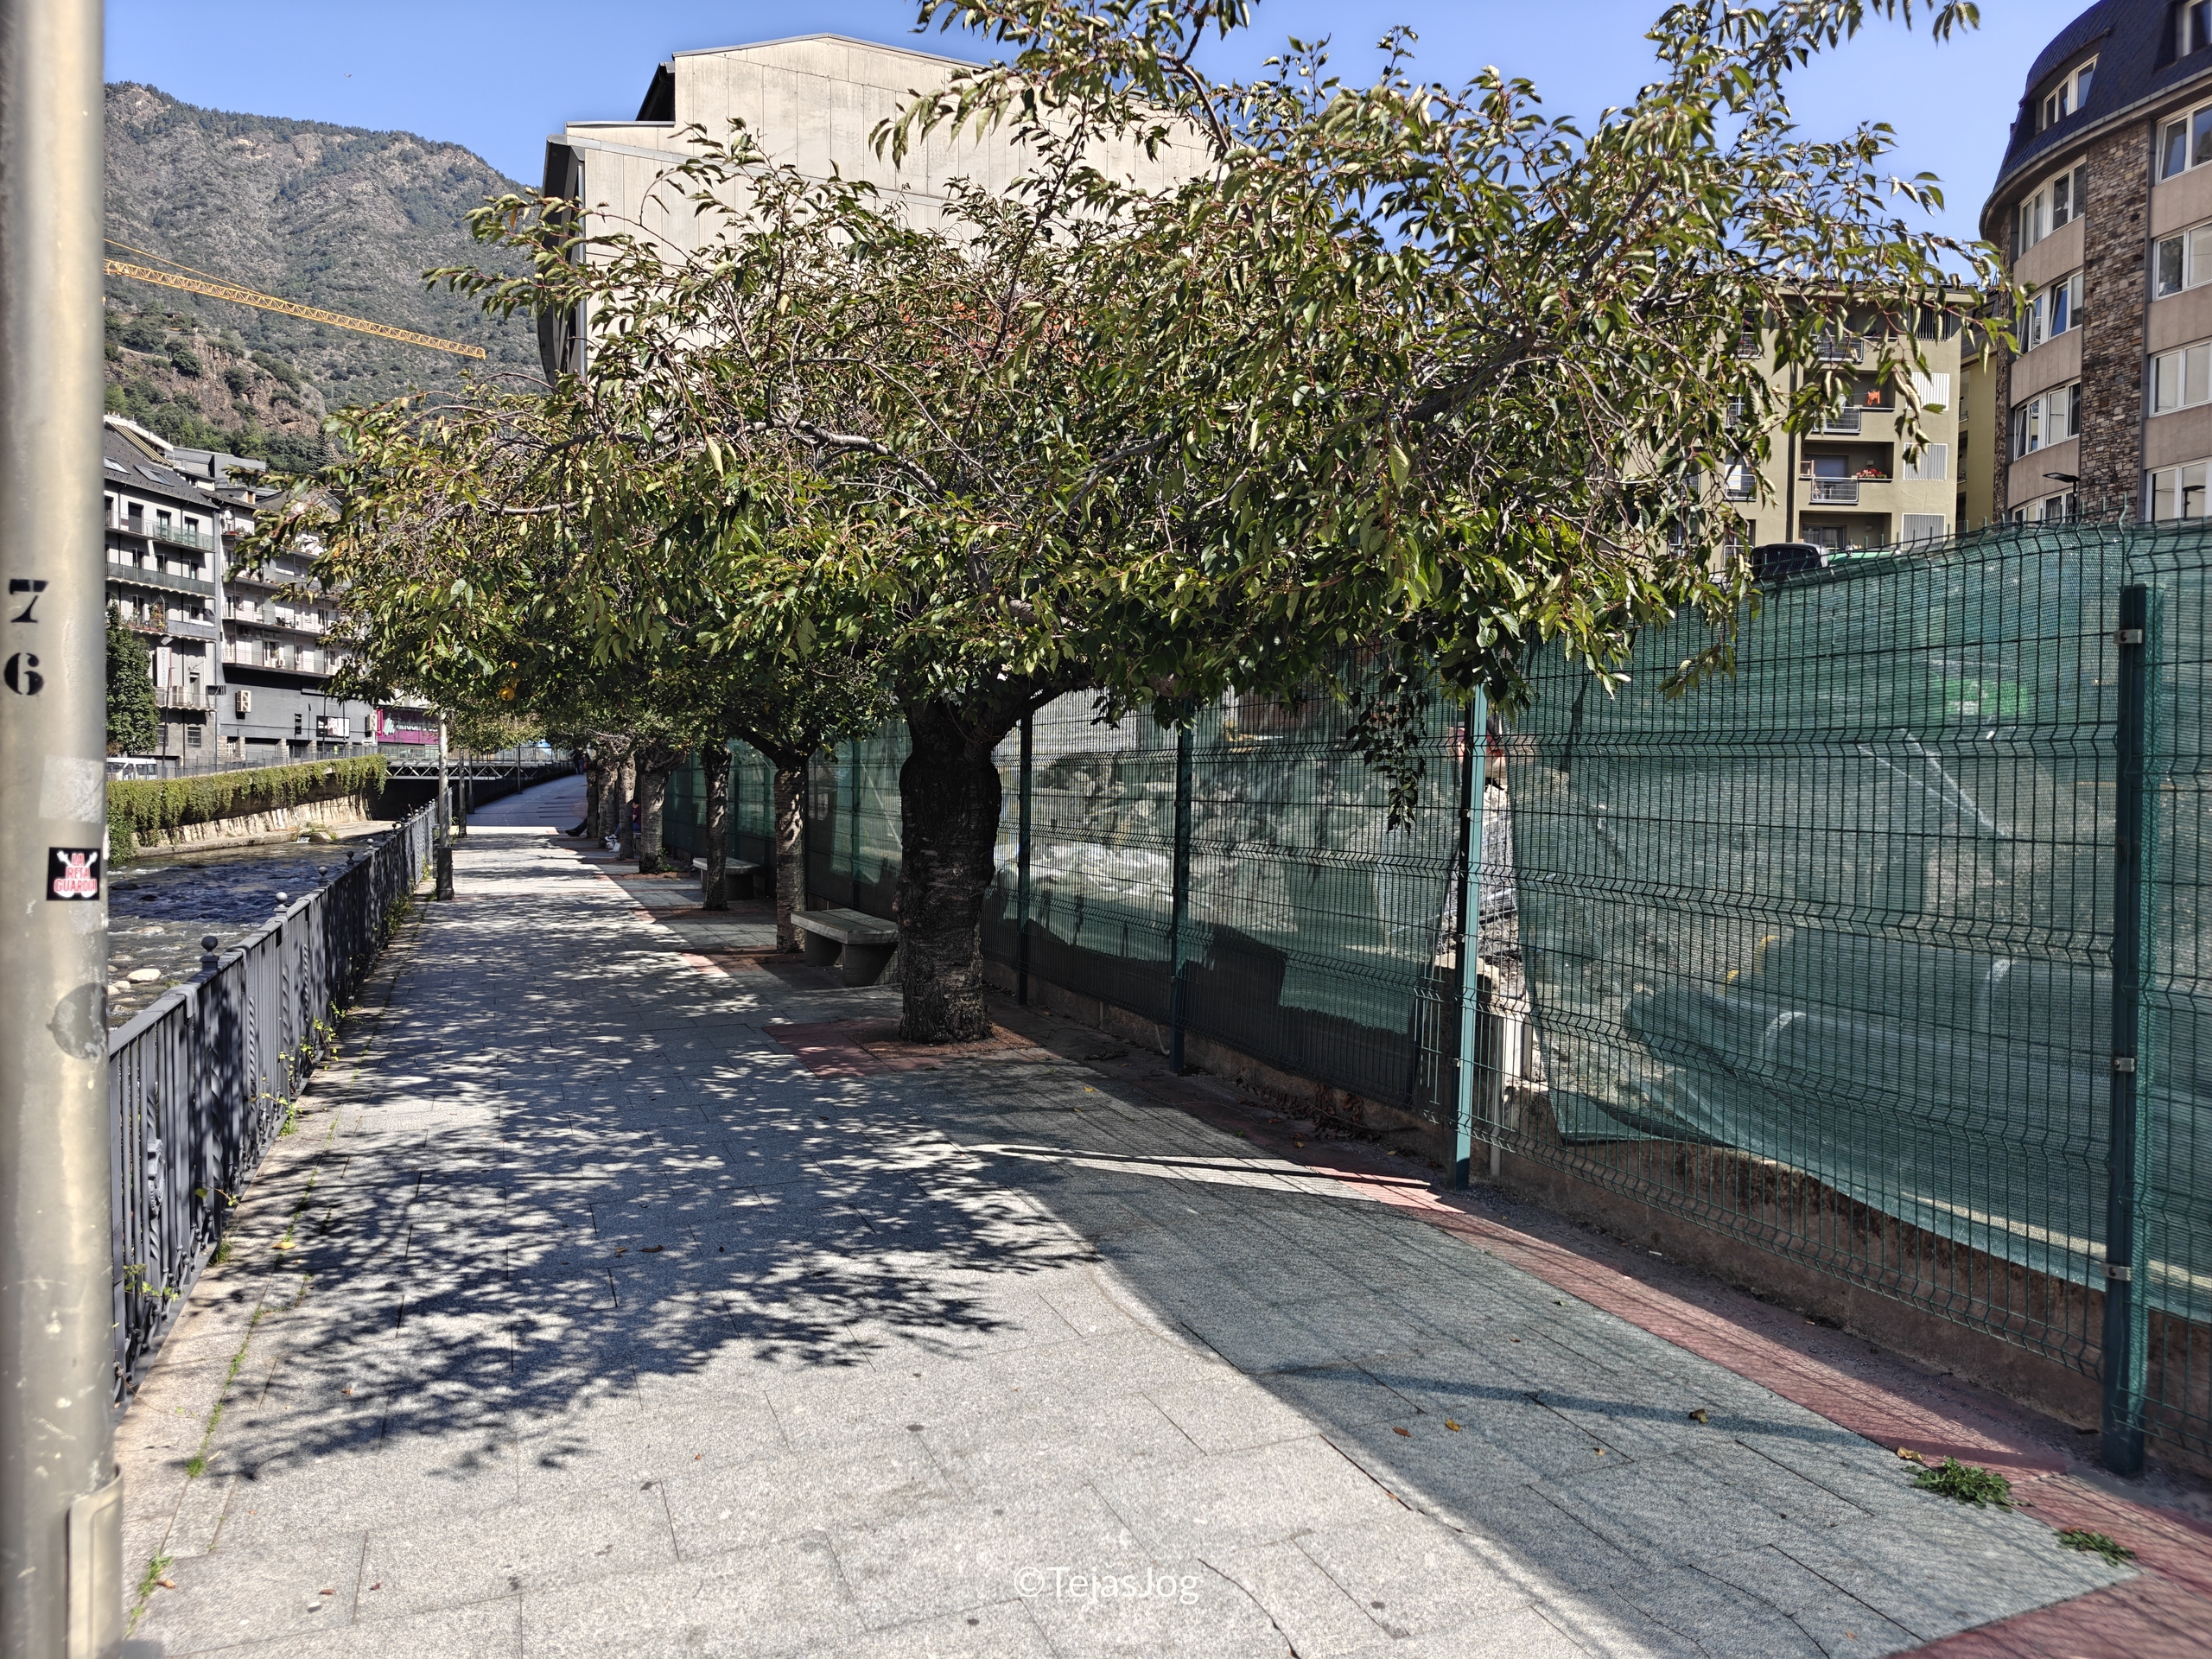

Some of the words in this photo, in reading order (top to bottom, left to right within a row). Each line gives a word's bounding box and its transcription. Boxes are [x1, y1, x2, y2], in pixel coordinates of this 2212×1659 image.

[71, 852, 85, 867] LA
[66, 866, 91, 879] RETA
[54, 879, 98, 893] GUARDIA
